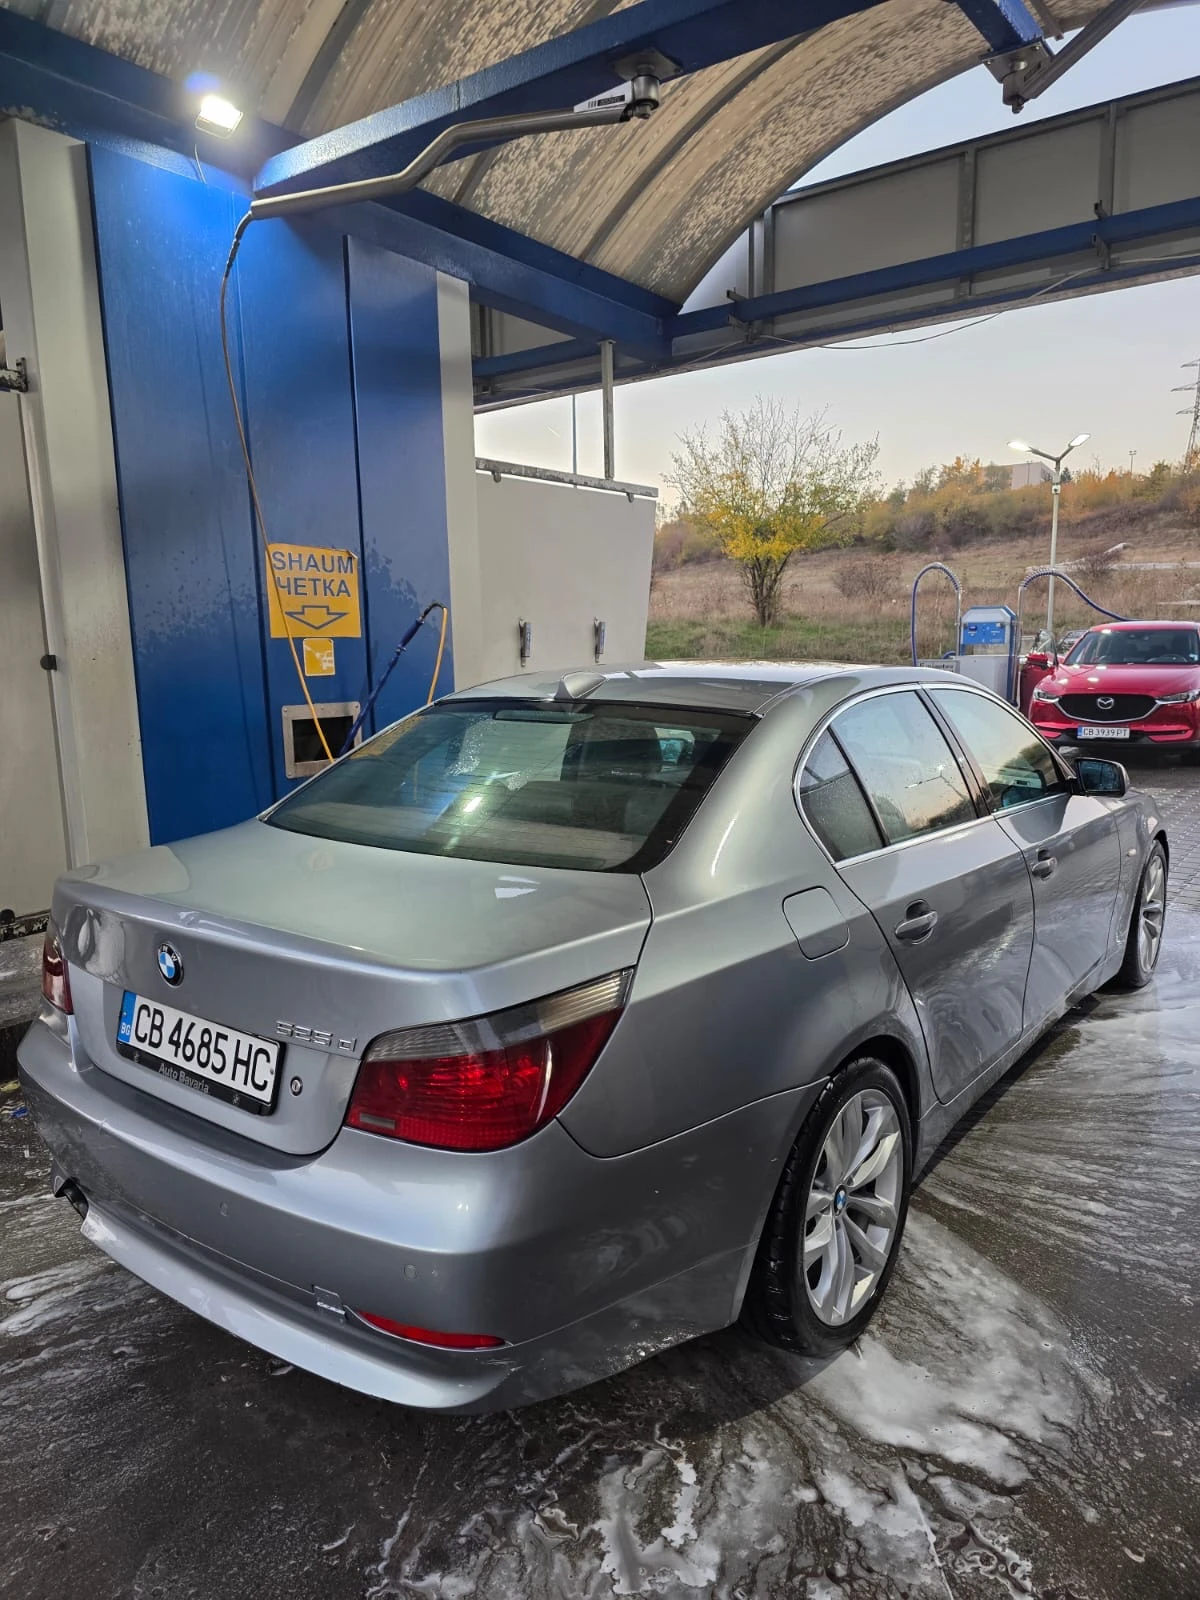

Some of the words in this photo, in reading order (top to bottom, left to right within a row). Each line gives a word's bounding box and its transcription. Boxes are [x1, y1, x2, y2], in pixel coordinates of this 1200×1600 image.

[272, 551, 354, 575] SHAUM
[276, 576, 351, 598] ЧЕТКА
[1095, 728, 1115, 737] 3939
[121, 1022, 131, 1036] BG
[134, 1003, 165, 1049] CB
[168, 1017, 229, 1075] 4685
[231, 1039, 271, 1092] HC
[158, 1063, 179, 1080] Auto
[179, 1070, 210, 1094] Bavaria
